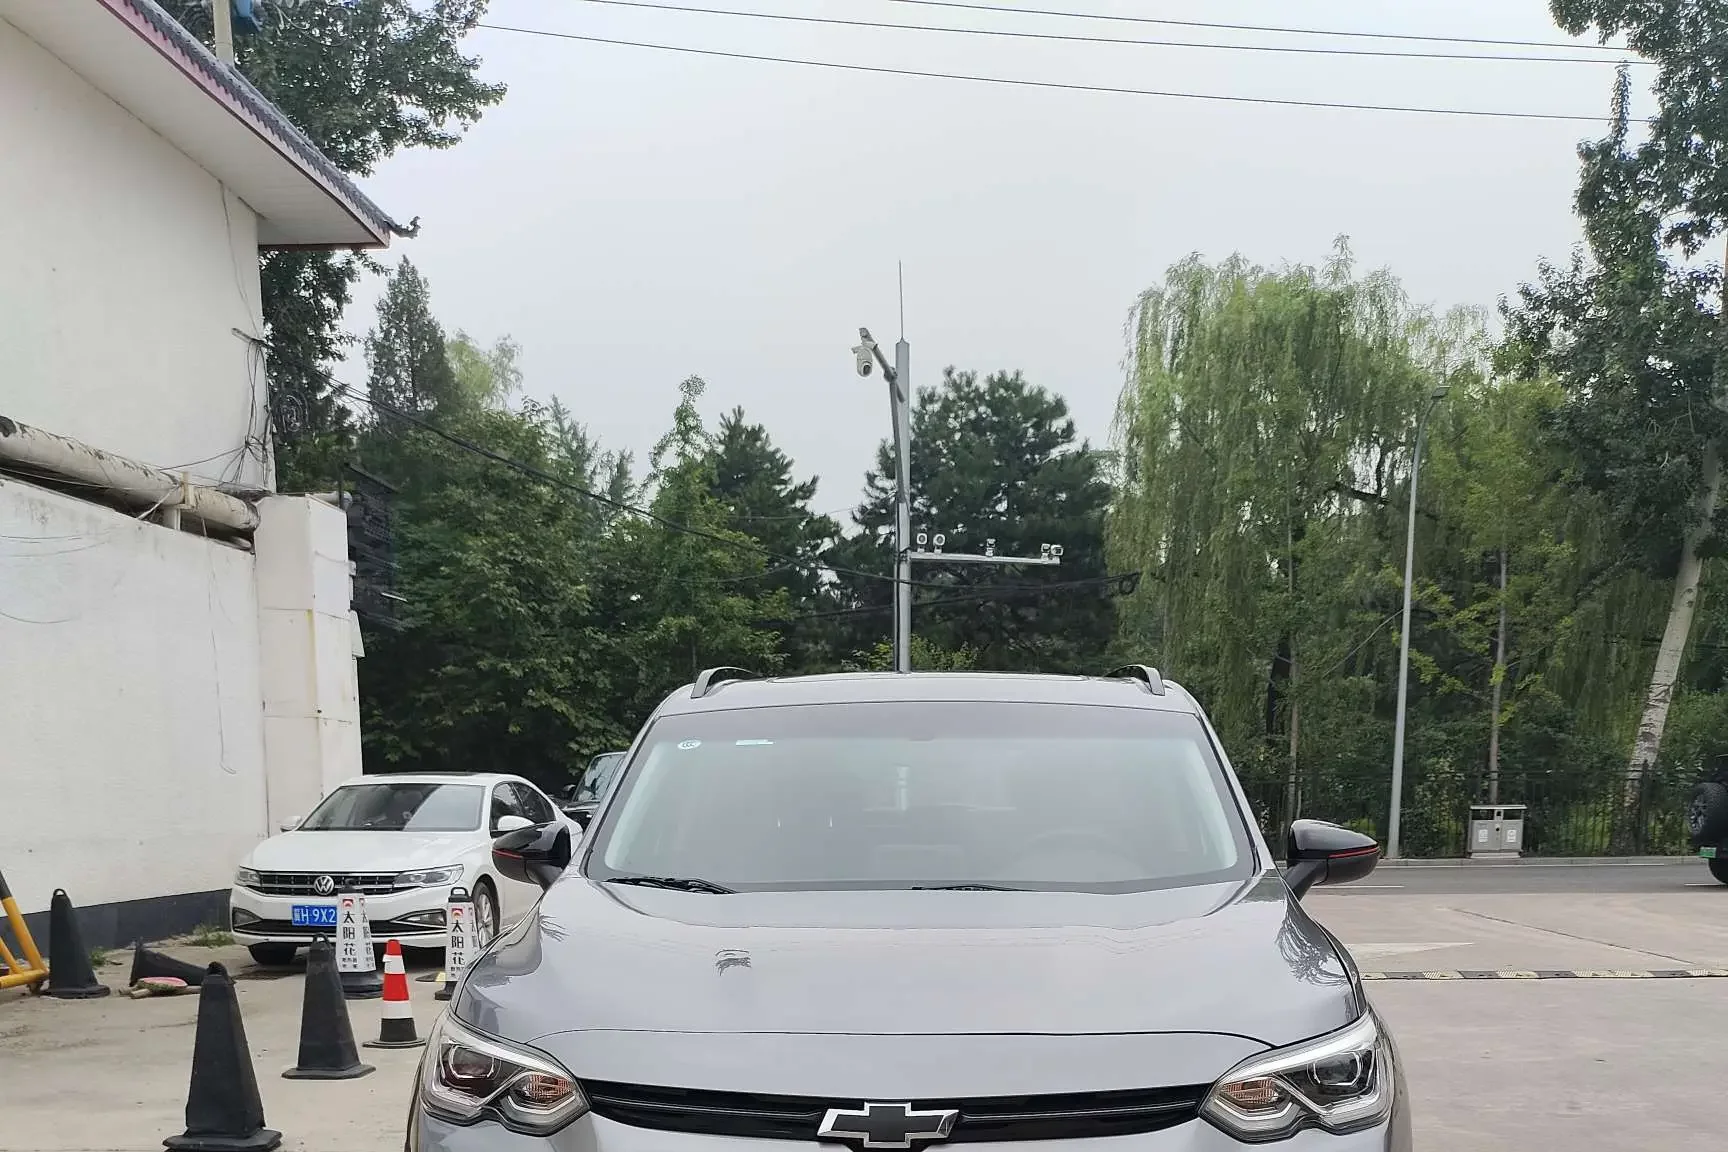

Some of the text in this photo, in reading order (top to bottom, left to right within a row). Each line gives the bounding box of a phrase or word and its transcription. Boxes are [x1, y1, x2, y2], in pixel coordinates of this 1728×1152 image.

[343, 911, 357, 955] 太阳花
[451, 919, 465, 965] 太阳花
